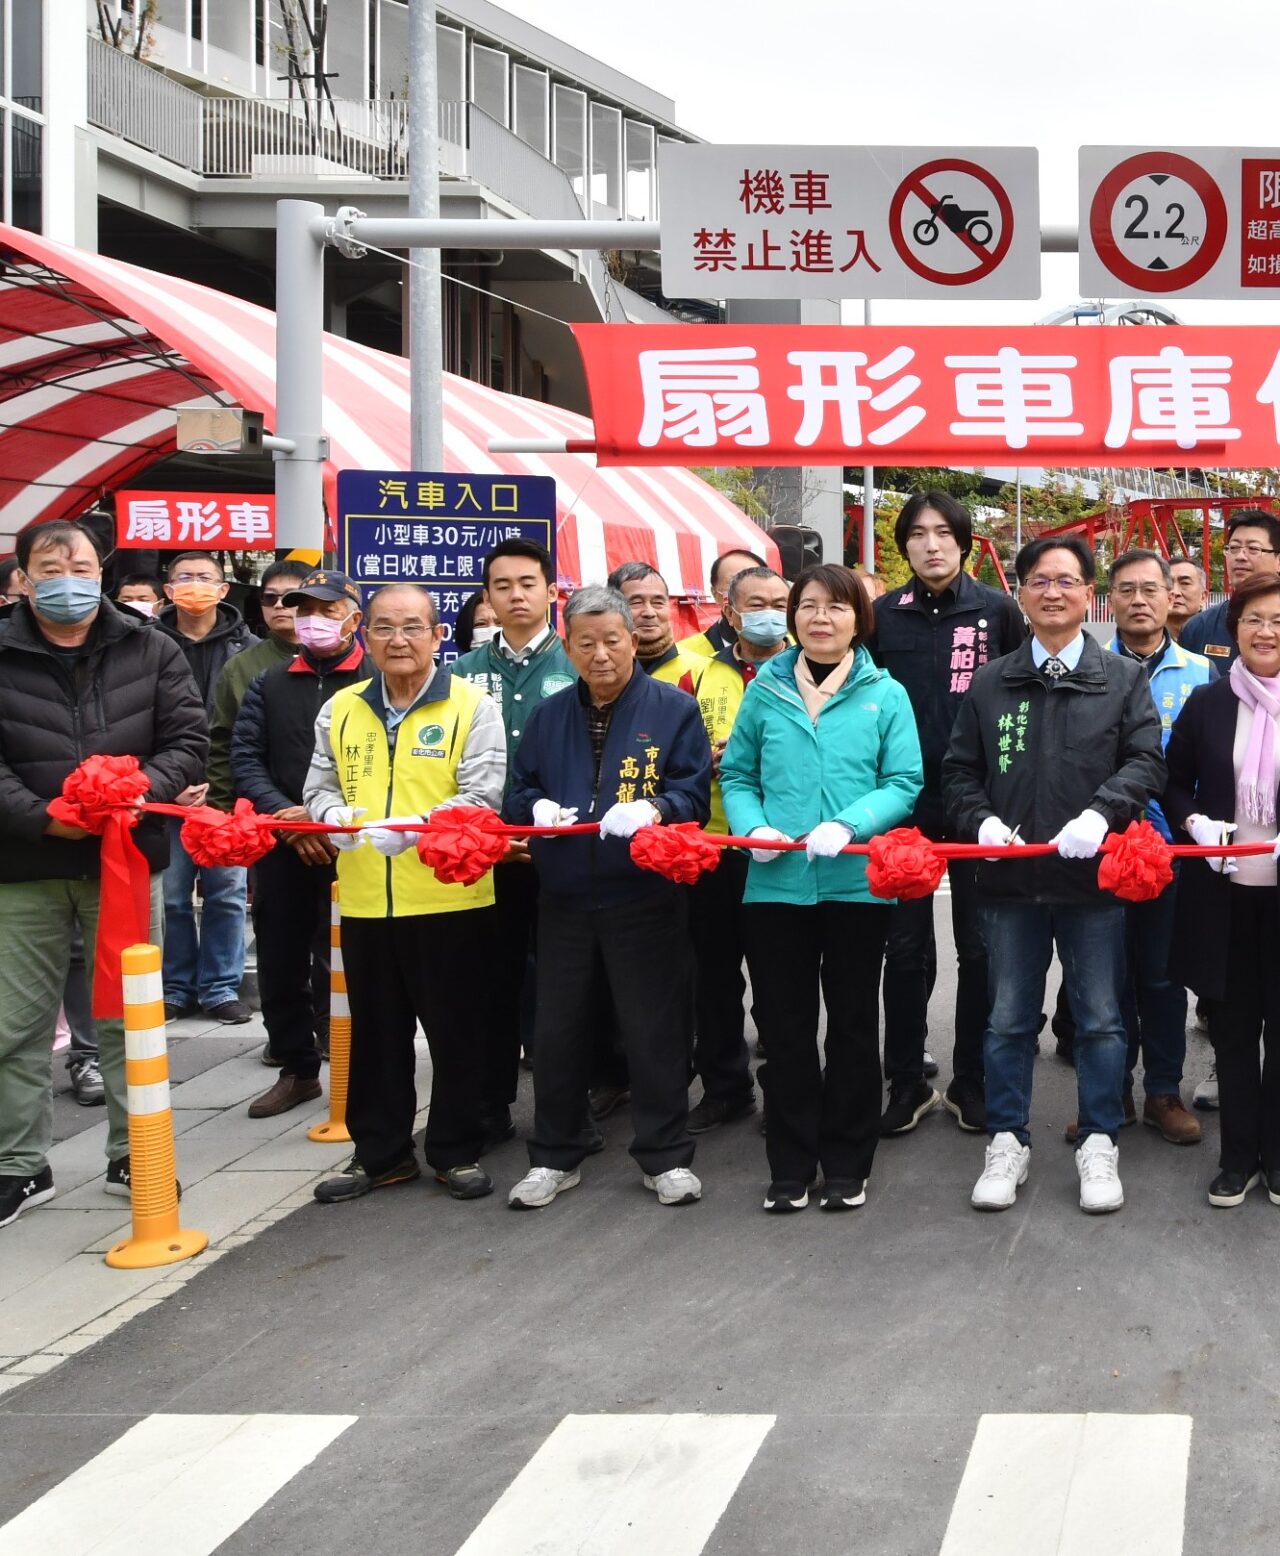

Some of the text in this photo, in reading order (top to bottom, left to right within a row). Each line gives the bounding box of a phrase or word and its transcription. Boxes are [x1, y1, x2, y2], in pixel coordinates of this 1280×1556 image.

[739, 169, 833, 215] 機車
[1124, 194, 1185, 239] 2.2
[693, 227, 882, 273] 禁止進入
[1181, 236, 1200, 246] 公尺
[378, 479, 518, 512] 汽車入口
[126, 500, 273, 543] 扇形車
[997, 713, 1015, 774] 林世賢
[1015, 701, 1030, 752] 彰化市長
[345, 744, 361, 803] 林正吉
[361, 732, 377, 777] 忠孝里長
